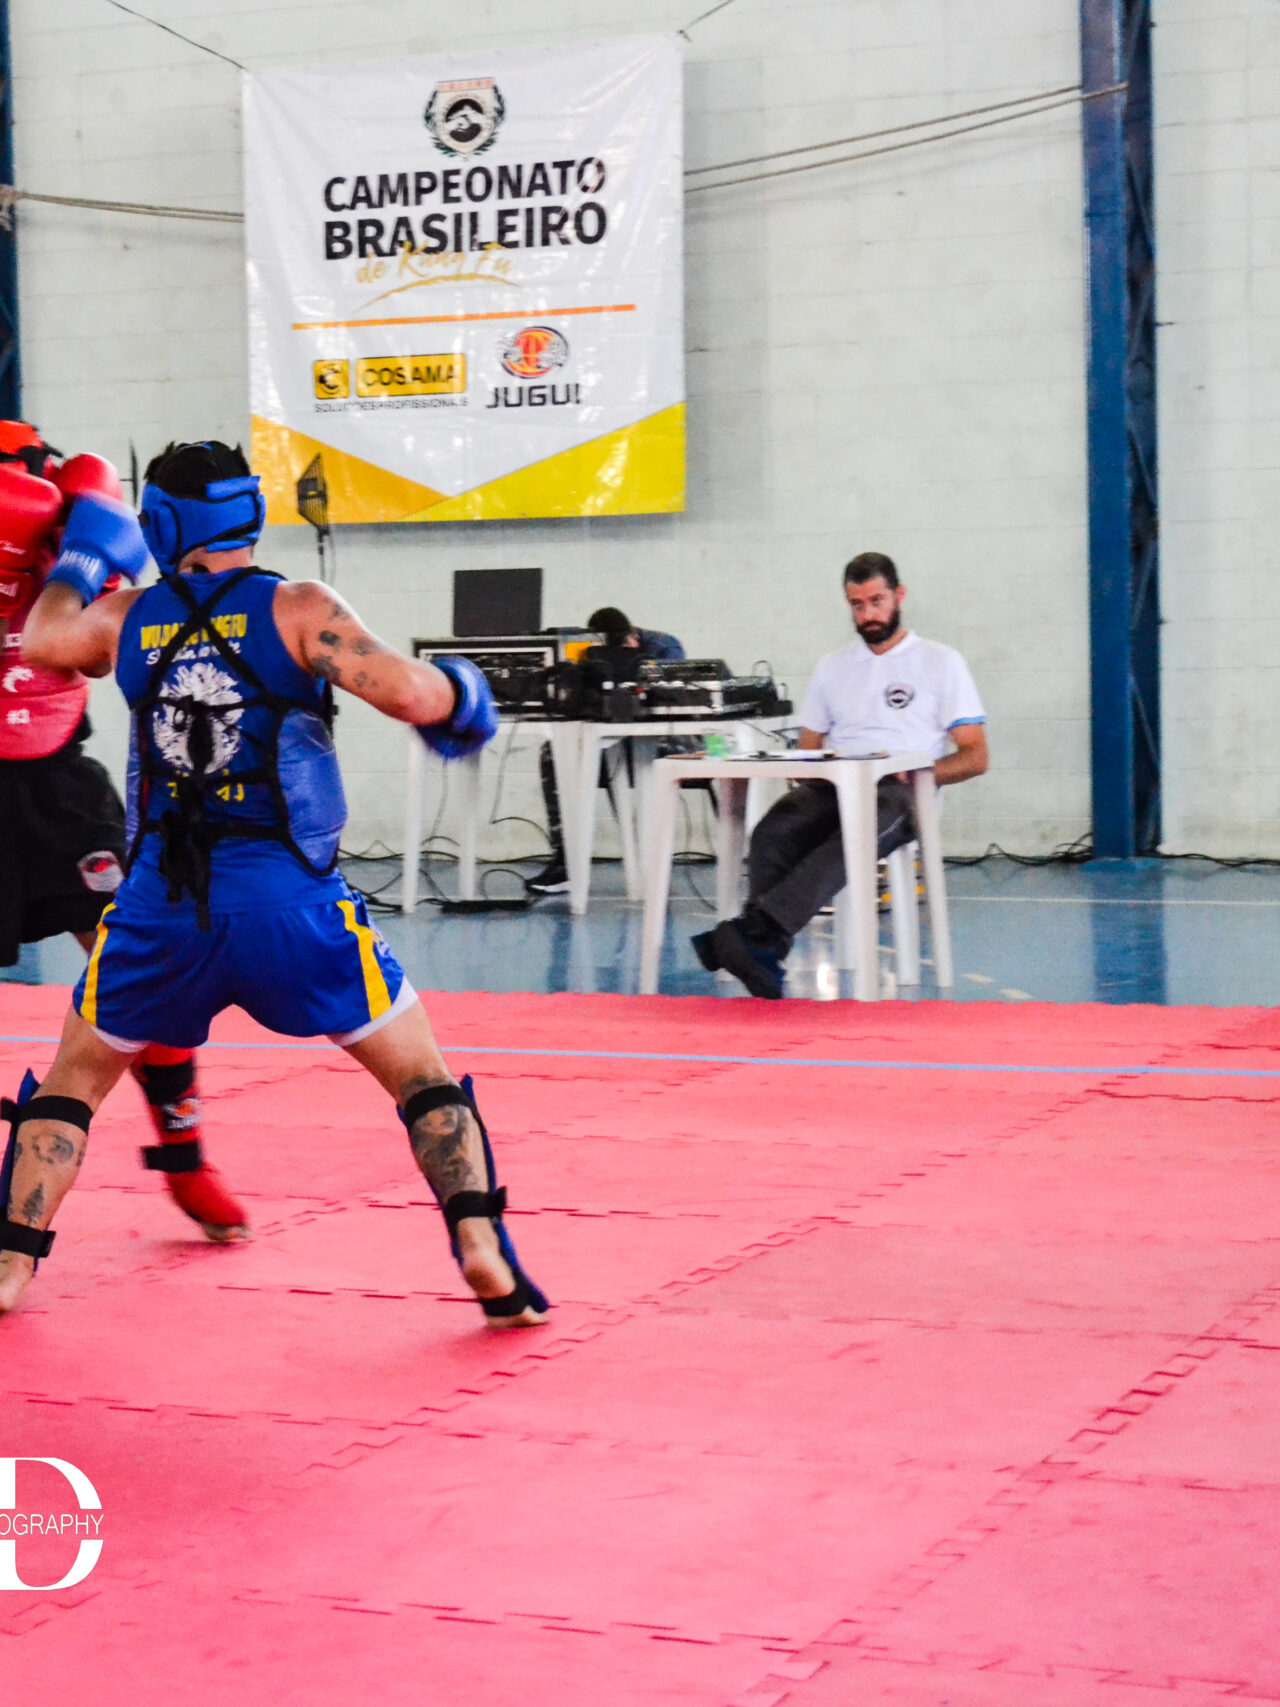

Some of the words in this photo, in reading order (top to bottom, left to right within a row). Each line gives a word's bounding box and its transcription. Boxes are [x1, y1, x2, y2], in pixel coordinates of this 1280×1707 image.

[324, 156, 606, 212] CAMPEONATO
[324, 201, 608, 260] BRASILEIRO
[362, 364, 457, 386] COSAMA
